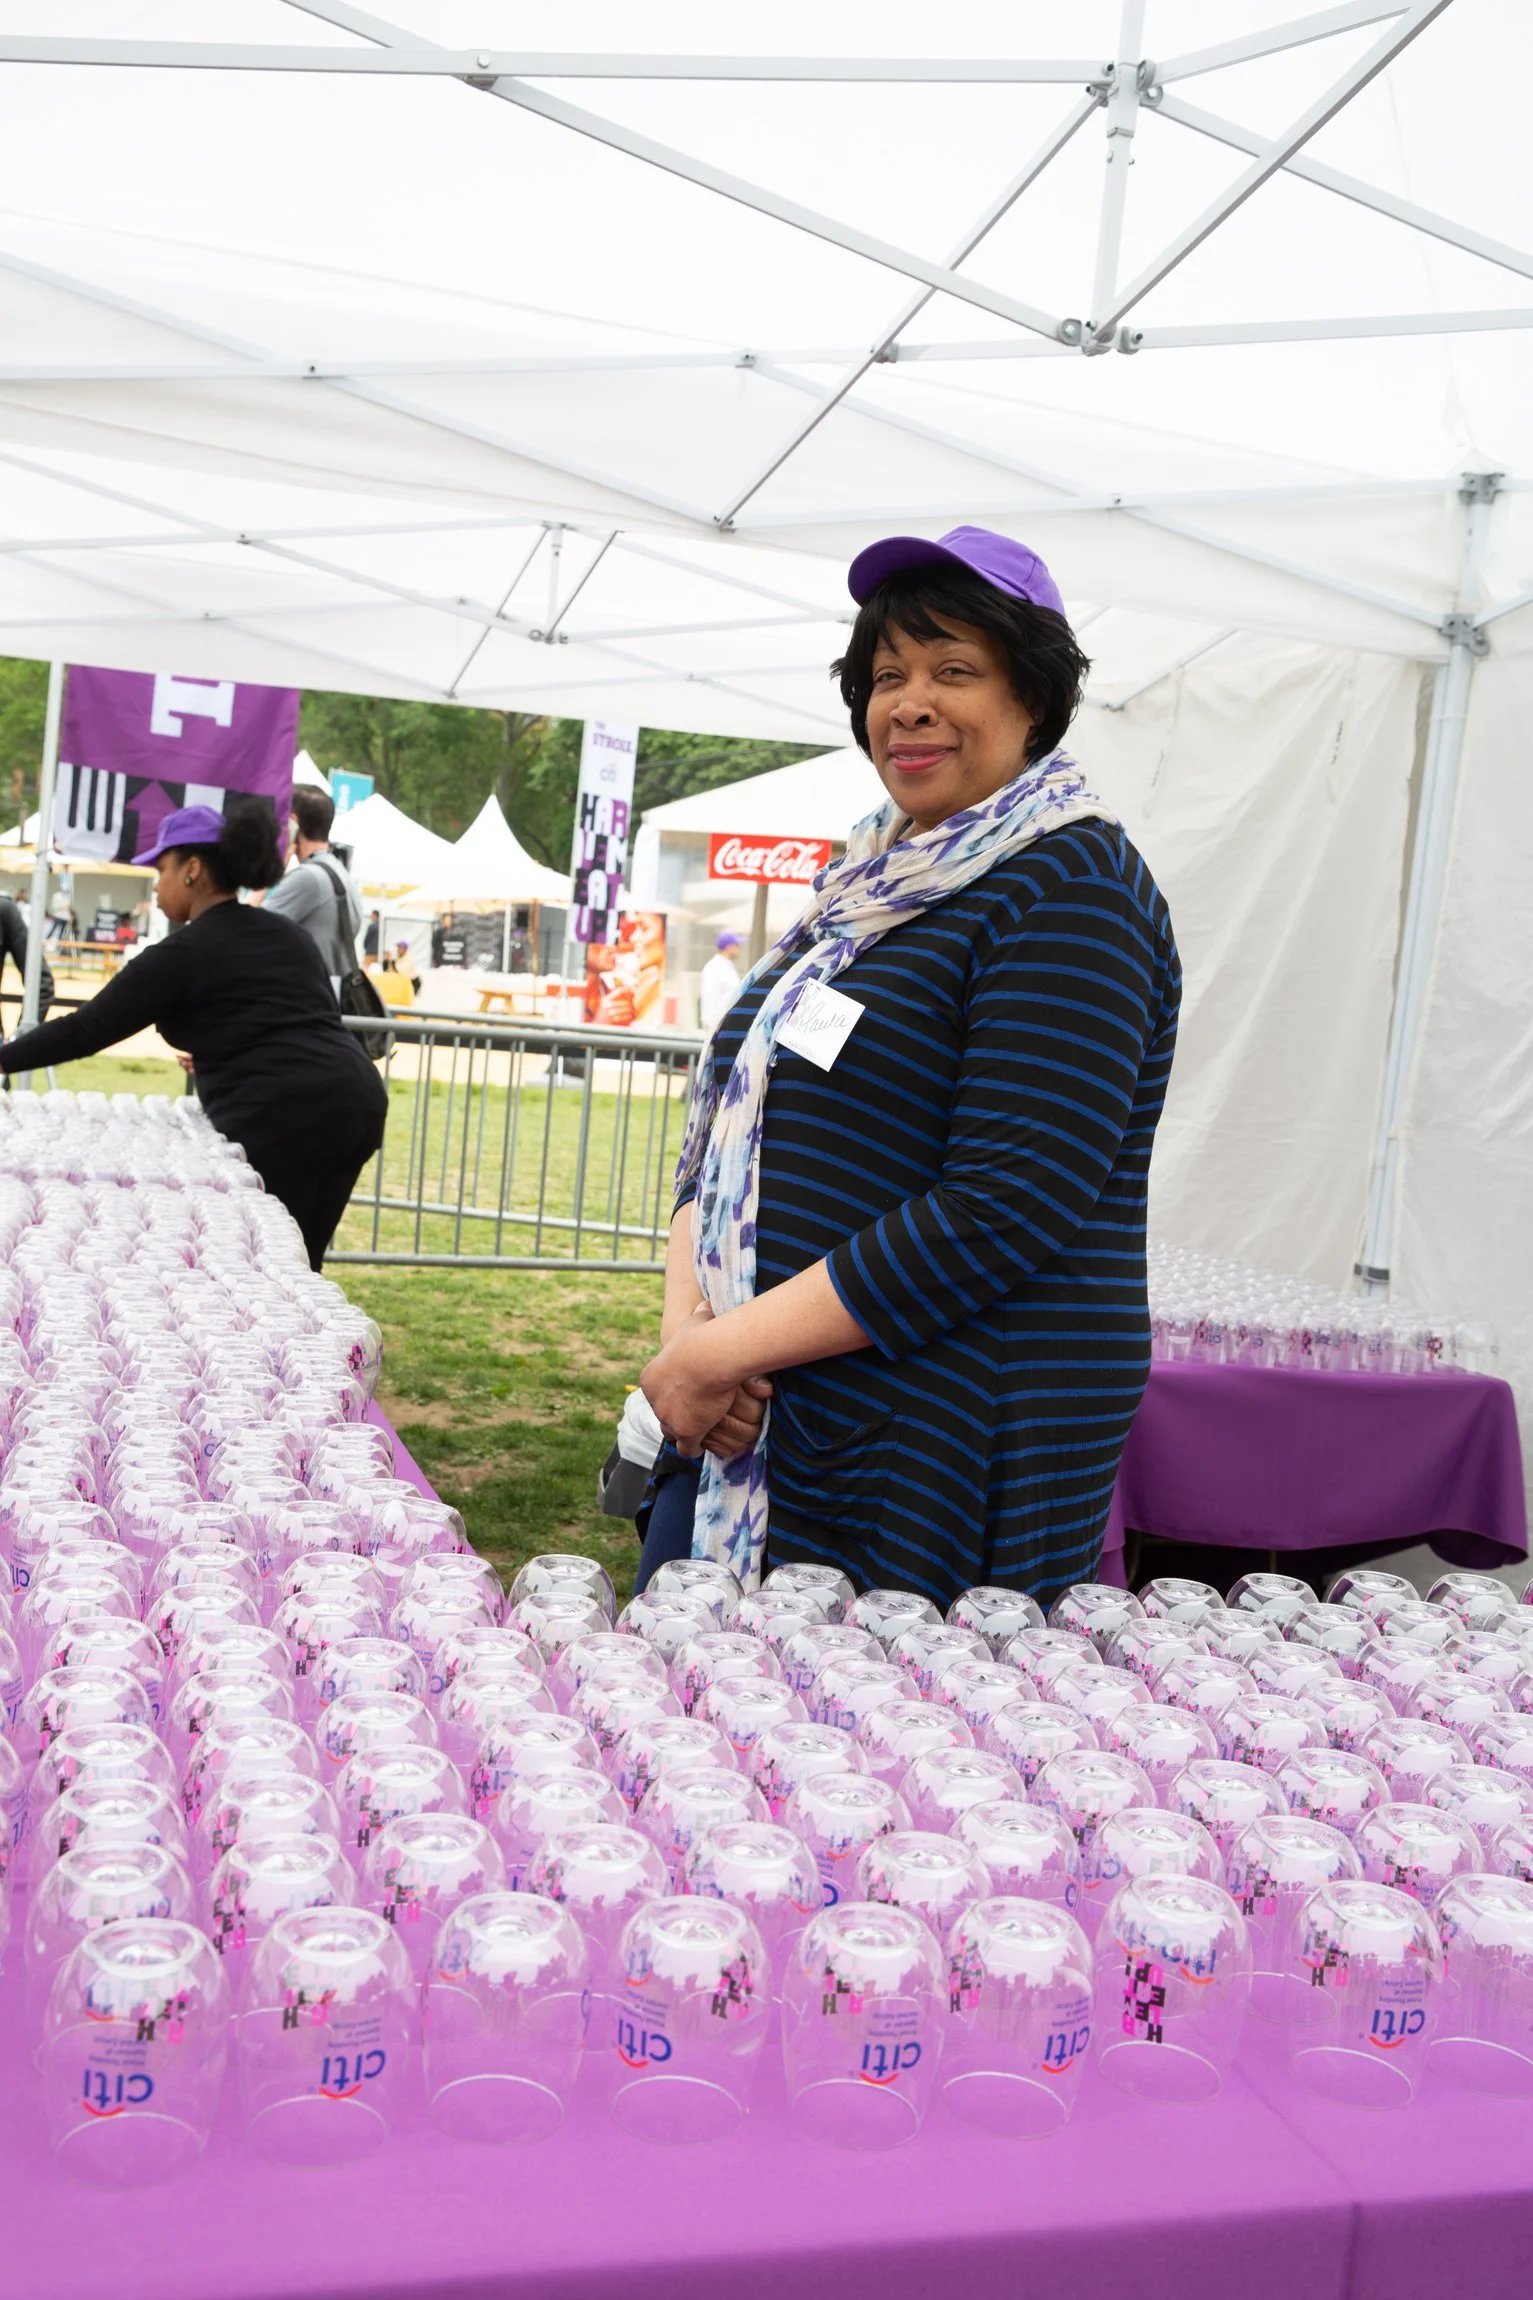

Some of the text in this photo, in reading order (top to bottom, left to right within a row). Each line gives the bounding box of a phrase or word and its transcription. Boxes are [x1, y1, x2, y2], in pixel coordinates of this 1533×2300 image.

[714, 838, 824, 880] Coca-Cola
[617, 2019, 672, 2061] citi
[1371, 2009, 1425, 2041] citi
[861, 2042, 922, 2078] citi
[1044, 2026, 1090, 2066] citi
[84, 2069, 155, 2109] citi
[321, 2050, 386, 2092] citi
